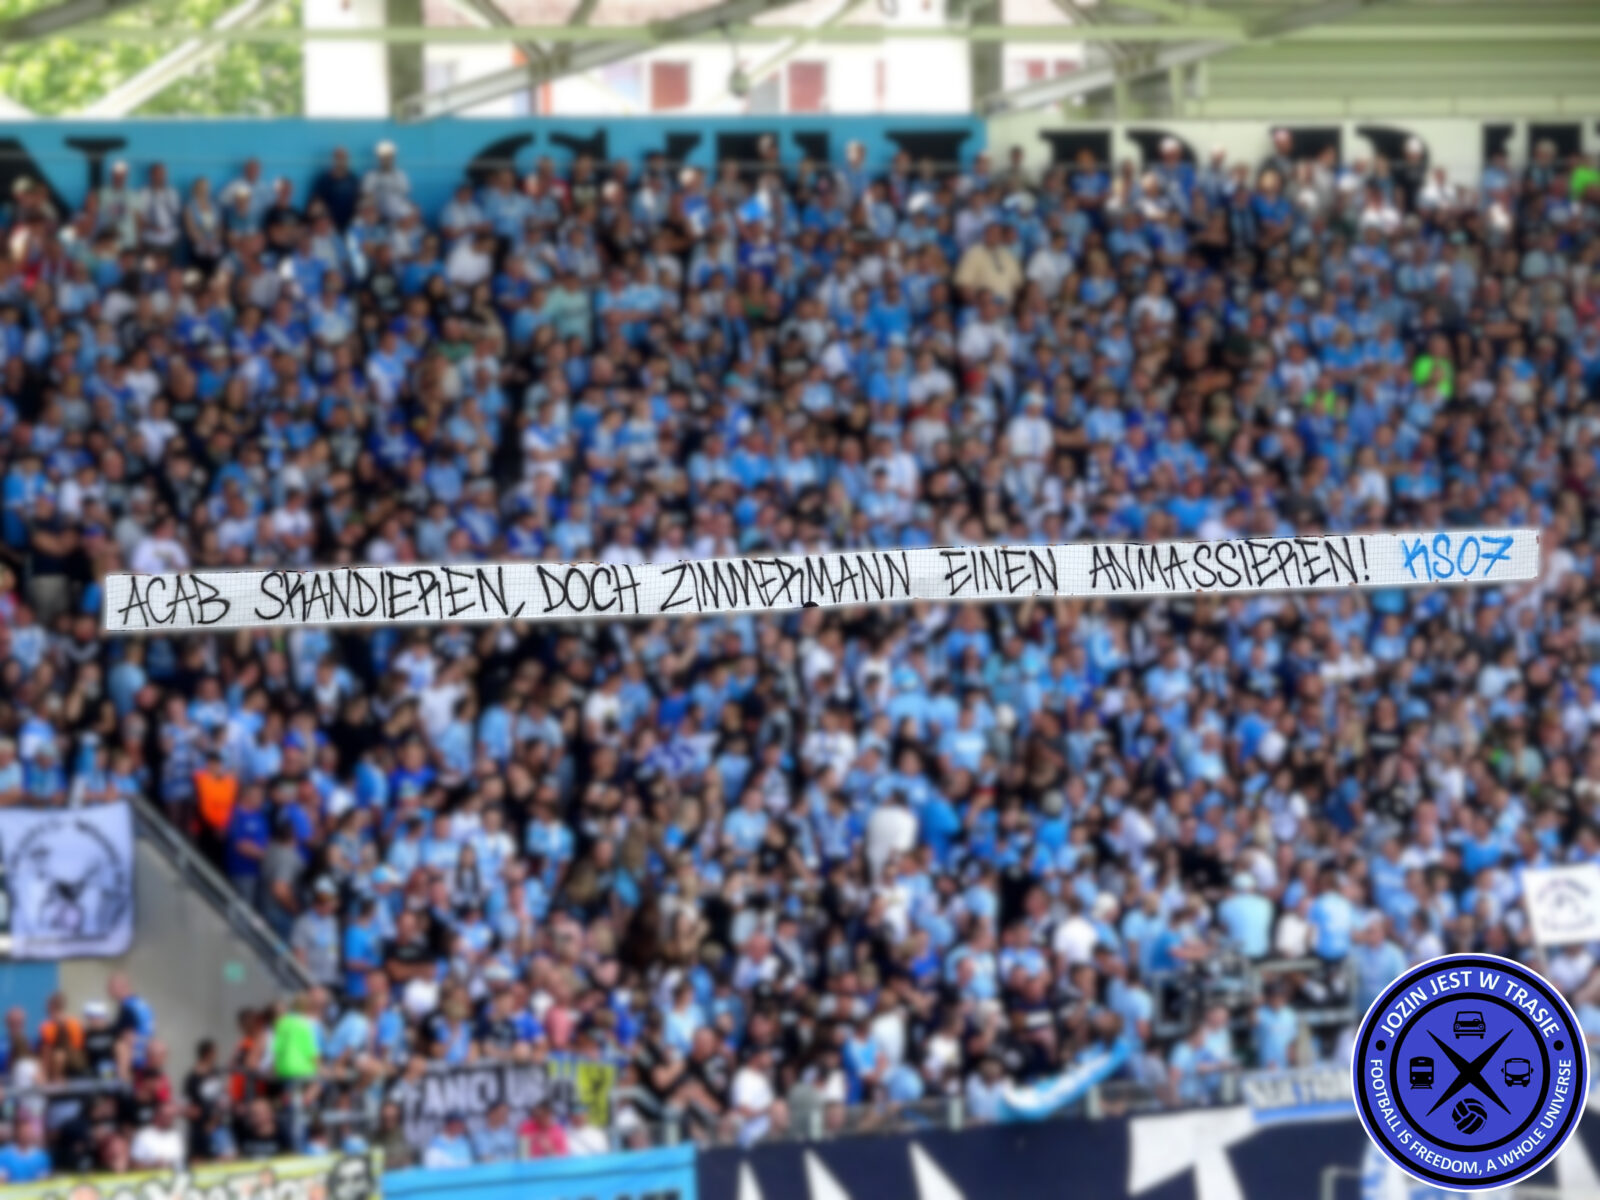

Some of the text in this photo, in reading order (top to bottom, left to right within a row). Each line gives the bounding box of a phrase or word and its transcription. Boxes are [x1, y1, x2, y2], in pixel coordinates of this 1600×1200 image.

[118, 575, 231, 627] ACAB
[254, 565, 526, 621] SKANDIEREN,
[536, 565, 641, 614] DOCH
[660, 552, 910, 612] ZIMMERMANN
[940, 548, 1058, 596] EINEN
[1088, 534, 1370, 591] ANMASSIEREN!
